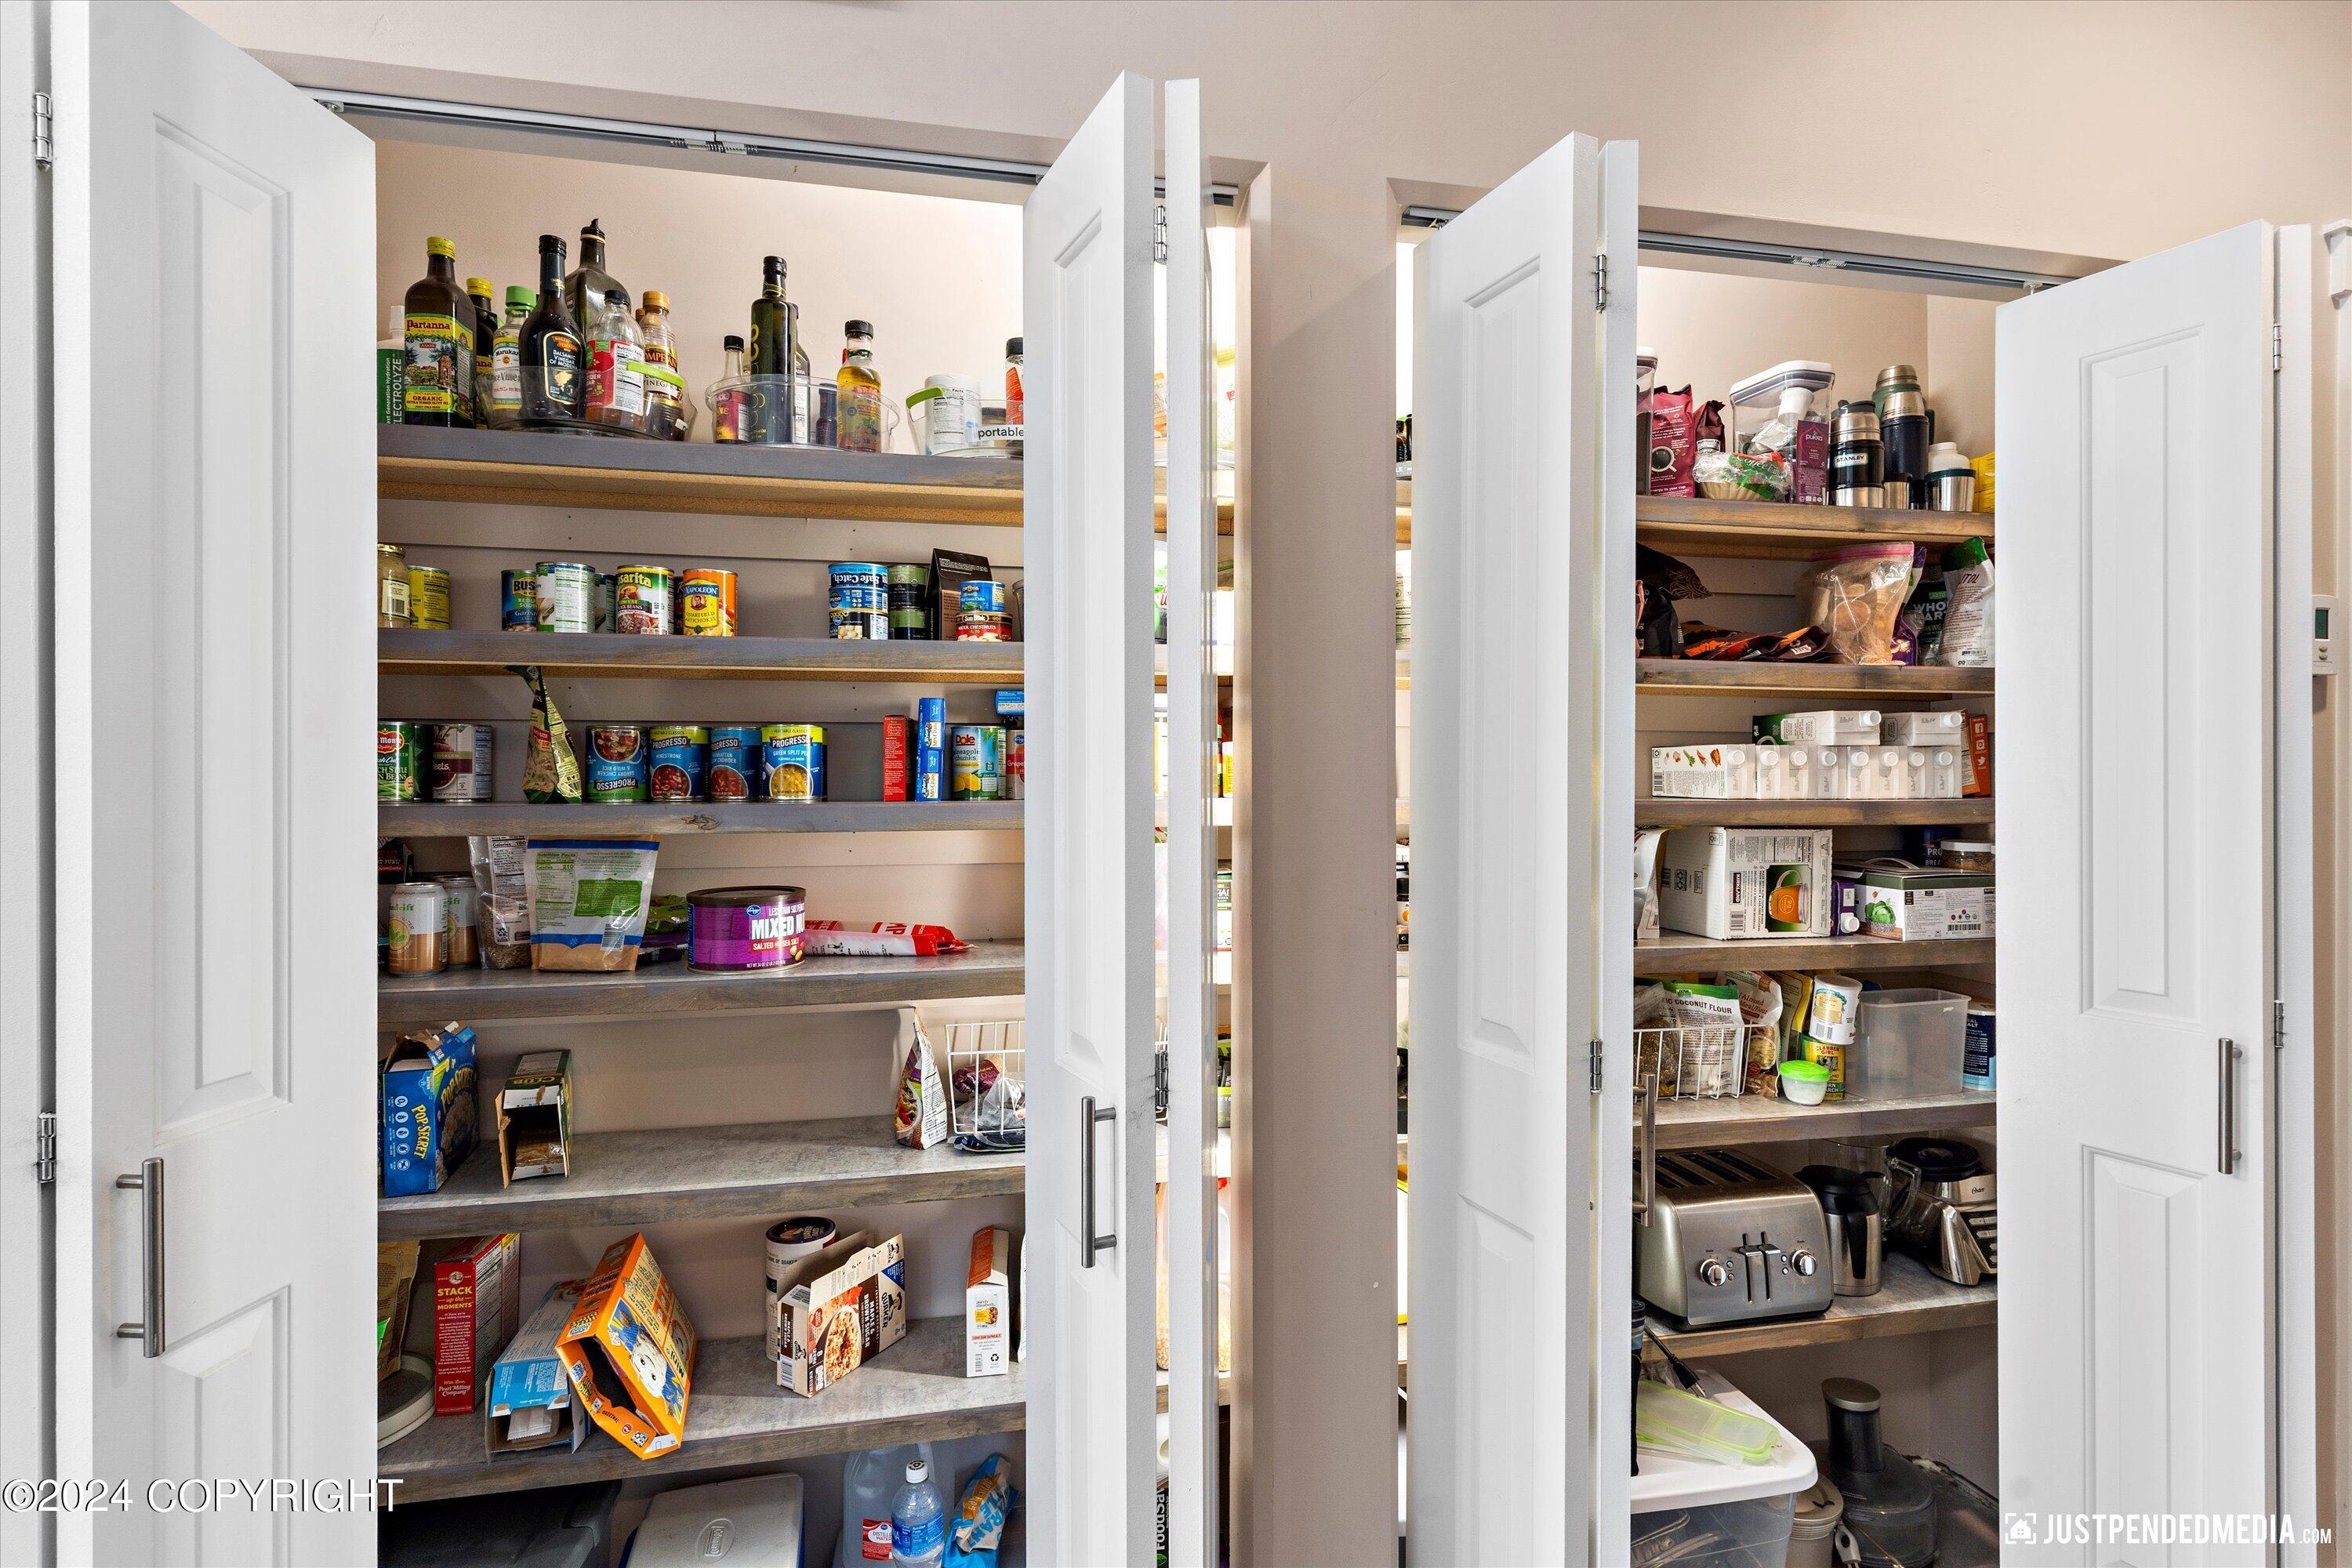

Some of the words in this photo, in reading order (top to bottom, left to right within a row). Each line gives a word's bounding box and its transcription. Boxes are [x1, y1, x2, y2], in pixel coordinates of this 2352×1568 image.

[406, 320, 450, 331] Partanna
[553, 350, 576, 361] BALSAMIC
[644, 353, 677, 368] OMPEAN
[393, 358, 402, 424] LECTROLYZE
[978, 427, 1024, 440] portable
[1836, 455, 1864, 463] STANLEY
[833, 574, 859, 583] Catch
[861, 575, 880, 584] Safe
[514, 580, 536, 592] BUS
[684, 586, 718, 595] NAPOLEON
[1914, 602, 1948, 612] WHO
[653, 737, 687, 749] PROGRESSO
[772, 735, 811, 748] PROGRESSO
[956, 735, 975, 744] Dole
[597, 779, 636, 791] PROGRESSO
[752, 916, 795, 939] MIXED
[753, 942, 775, 950] SALTED
[1741, 995, 1764, 1005] Almond
[1675, 999, 1708, 1009] COCONUT
[1709, 1004, 1732, 1014] FLOUR
[437, 1287, 472, 1296] STACK
